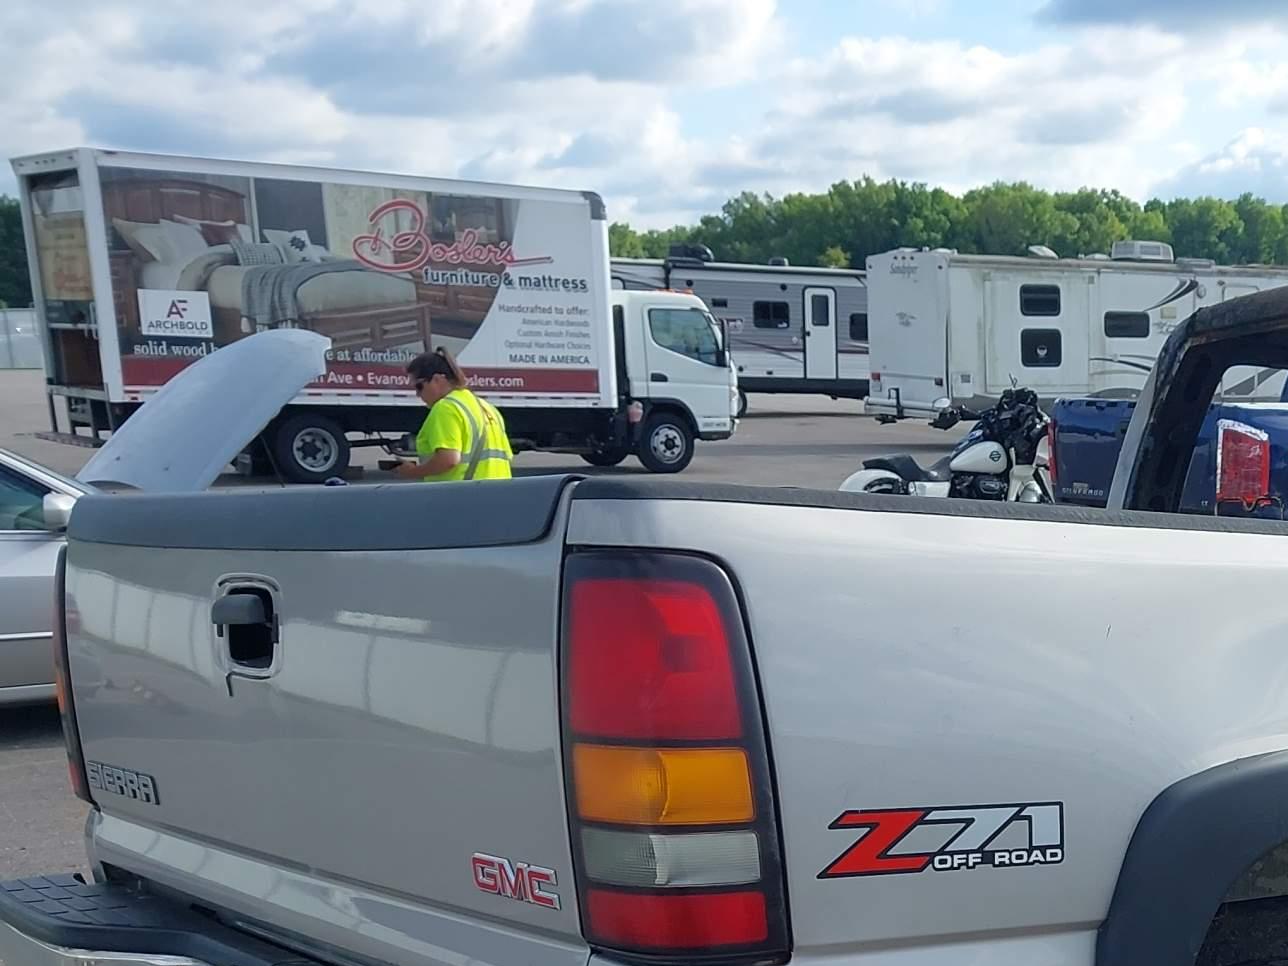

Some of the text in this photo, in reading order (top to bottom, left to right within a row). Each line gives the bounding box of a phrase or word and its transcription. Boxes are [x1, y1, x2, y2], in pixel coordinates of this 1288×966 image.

[422, 268, 588, 291] furniture & mattress
[497, 304, 552, 315] Handcrafted
[554, 305, 564, 315] to
[147, 320, 209, 331] ARCHBOLD
[133, 340, 168, 356] solid
[171, 342, 207, 357] wood
[337, 350, 351, 361] at
[509, 354, 591, 365] MADE IN AMERICA
[327, 372, 353, 384] Ave
[367, 372, 411, 386] Evansv
[463, 376, 525, 388] oslers.com
[87, 760, 160, 806] SIERRA
[816, 801, 1065, 880] Z71
[933, 847, 1063, 870] OFF ROAD
[471, 852, 562, 911] GMC
